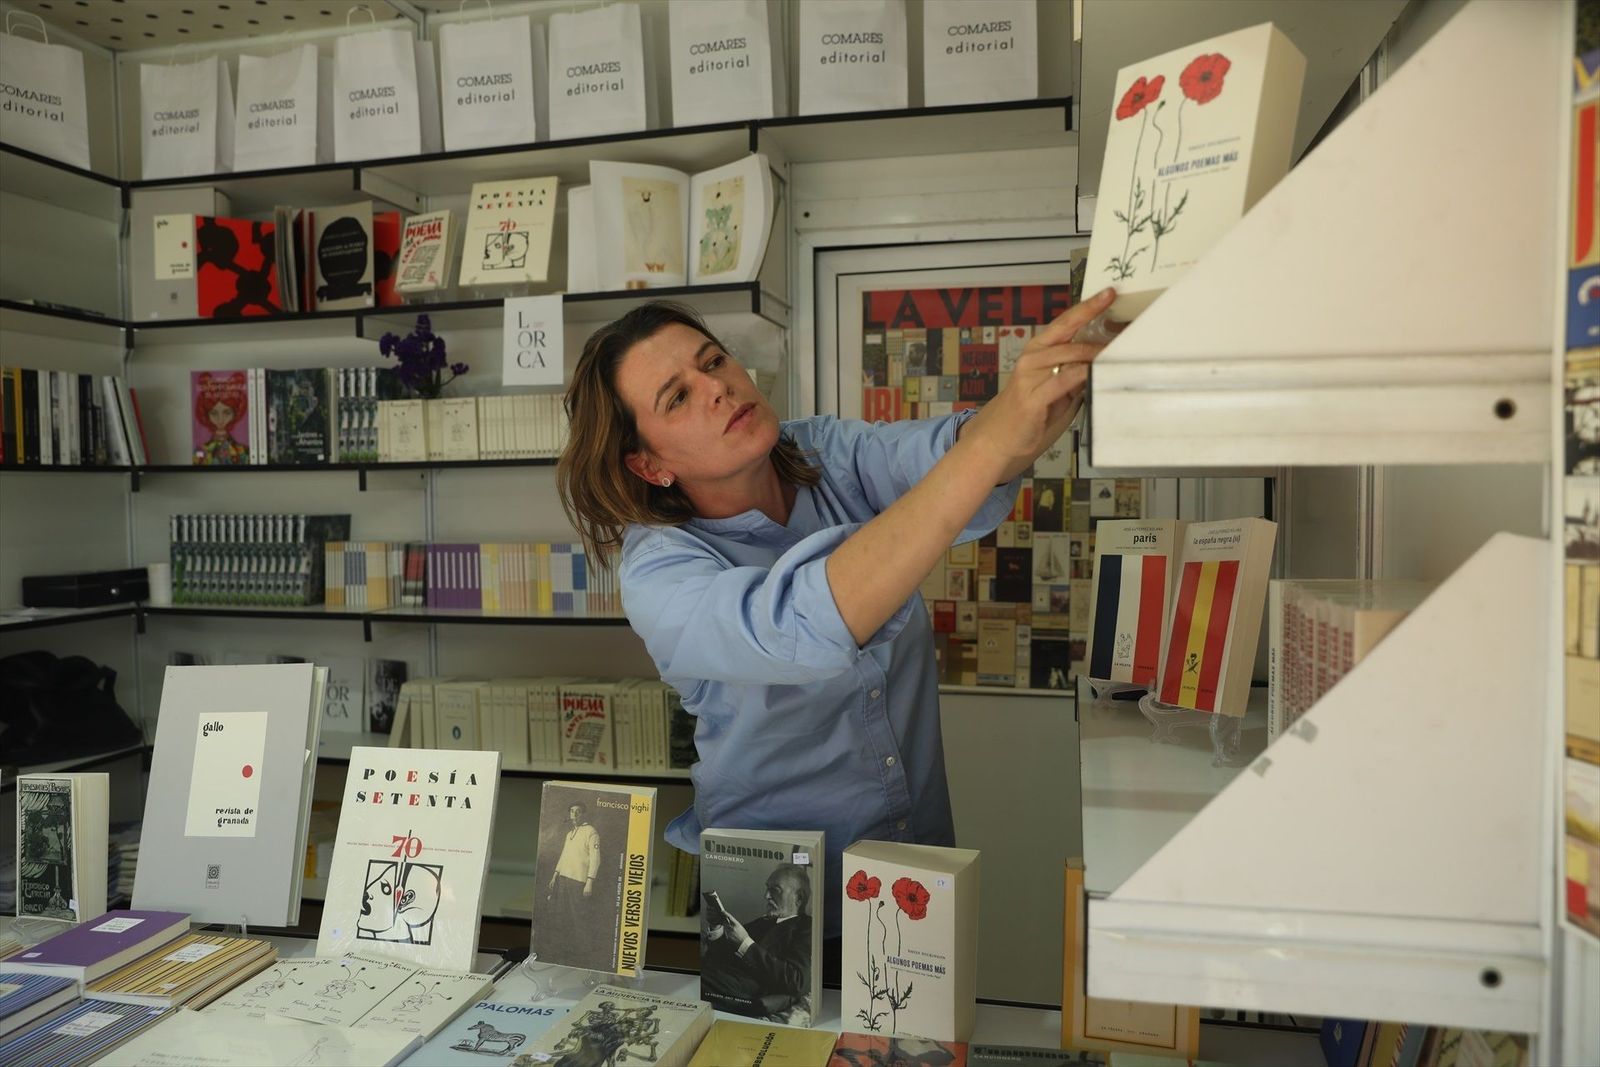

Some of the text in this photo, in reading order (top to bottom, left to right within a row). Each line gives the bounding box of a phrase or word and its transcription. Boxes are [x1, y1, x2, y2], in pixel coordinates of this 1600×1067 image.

[947, 20, 1012, 36] COMARES
[690, 37, 747, 55] COMARES
[822, 33, 883, 45] COMARES
[946, 38, 1014, 54] editorial
[690, 56, 750, 74] editorial
[821, 51, 886, 64] editorial
[567, 62, 621, 78] COMARES
[457, 74, 512, 87] COMARES
[567, 79, 624, 96] editorial
[349, 86, 396, 102] COMARES
[457, 90, 515, 105] editorial
[0, 100, 65, 122] ditorial
[250, 98, 296, 113] COMARES
[350, 103, 399, 119] editorial
[154, 109, 200, 122] COMARES
[248, 114, 297, 129] editorial
[152, 122, 200, 137] editorial
[1158, 161, 1190, 177] ALGUNOS
[1191, 155, 1221, 170] POEMAS
[863, 289, 926, 329] LA
[563, 697, 605, 712] POEMA
[203, 721, 224, 737] gallo
[363, 768, 478, 786] POESÍA
[355, 790, 472, 809] SETENTA
[596, 799, 650, 814] francisco vighi
[215, 807, 254, 815] revista de
[217, 817, 249, 827] granada
[391, 834, 423, 859] 70
[704, 839, 785, 861] Unamuno
[705, 853, 745, 864] CANCIONERO
[621, 853, 645, 971] NUEVOS VERSOS VIEJOS
[887, 955, 911, 968] ALGUNOS
[911, 960, 934, 973] POEMAS
[934, 963, 946, 975] MÁS
[607, 989, 650, 1003] AUDIENCIA
[662, 999, 675, 1007] DE
[676, 1000, 699, 1010] CAZA
[475, 1001, 555, 1017] PALOMAS
